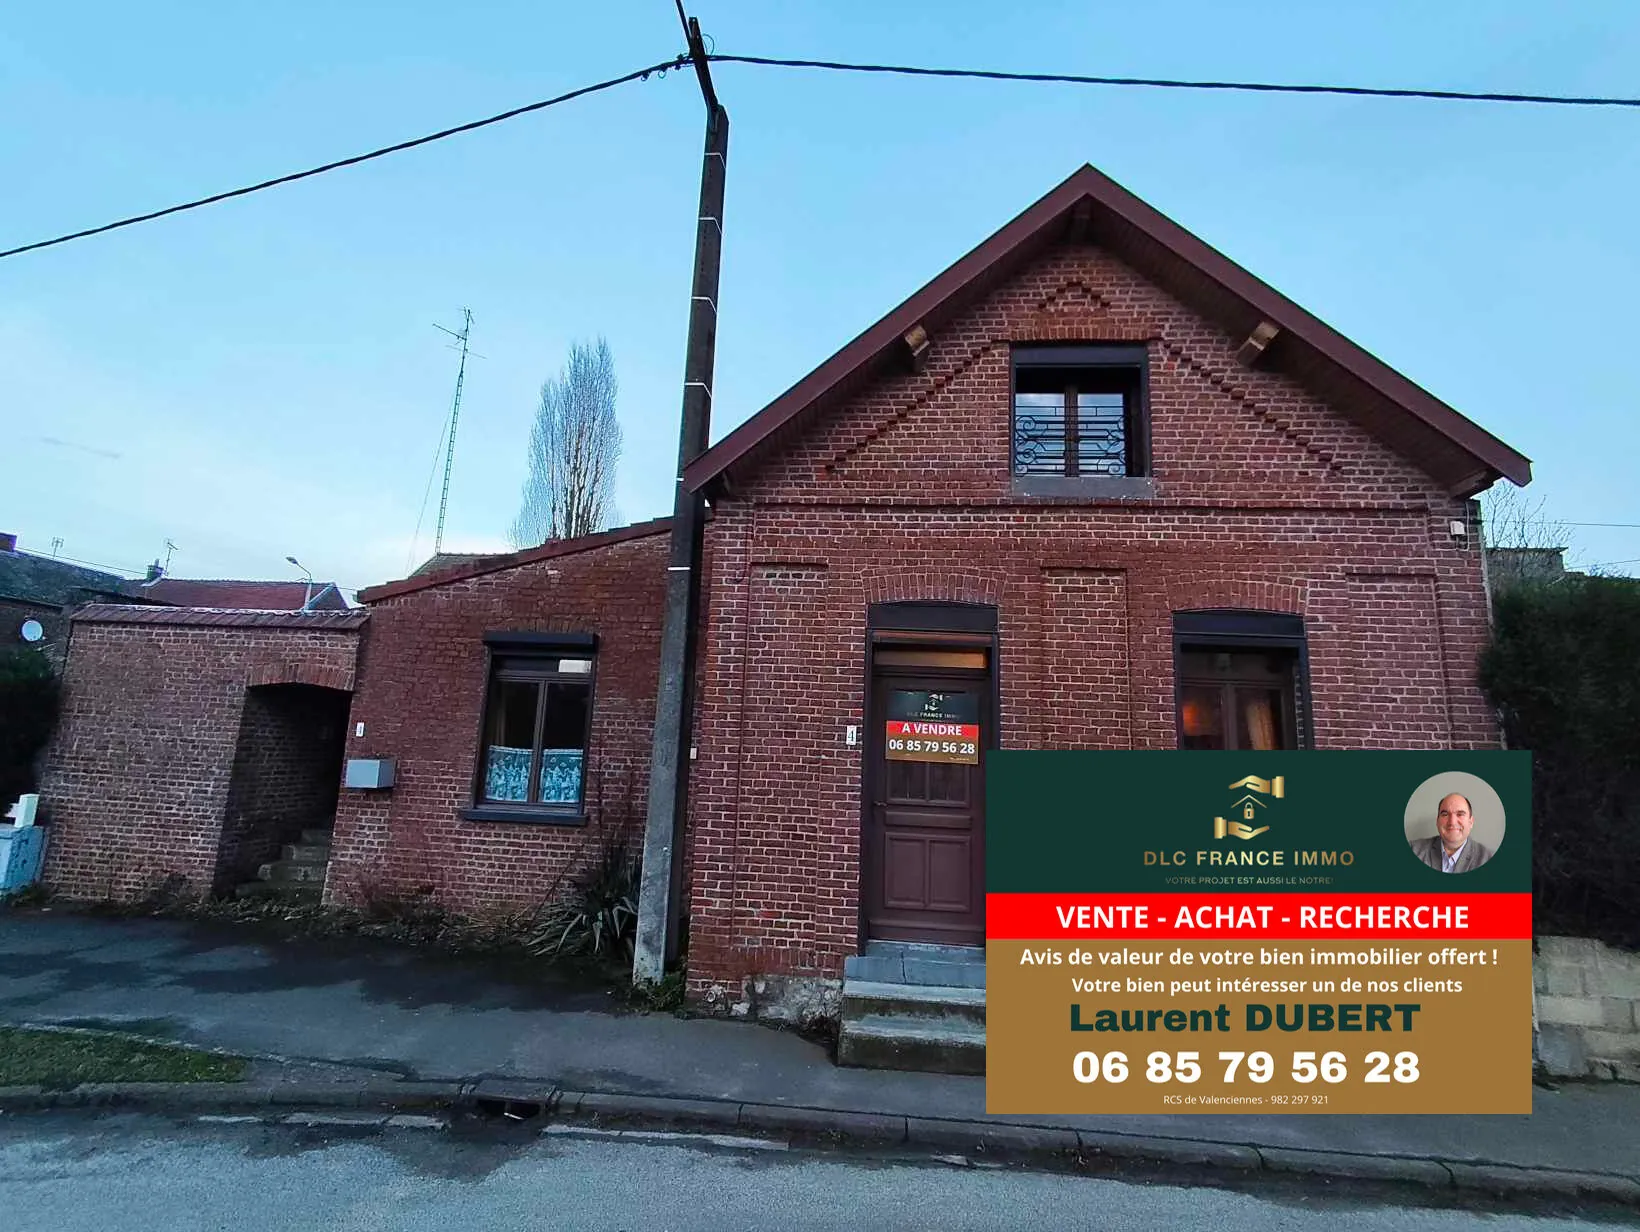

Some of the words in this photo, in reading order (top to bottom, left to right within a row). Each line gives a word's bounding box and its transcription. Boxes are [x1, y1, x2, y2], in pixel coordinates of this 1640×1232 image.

[901, 722, 911, 733] A
[913, 723, 962, 736] VENDRE
[889, 739, 904, 750] 06
[906, 740, 921, 751] 85
[924, 741, 939, 752] 79
[942, 742, 957, 753] 56
[959, 743, 975, 754] 28
